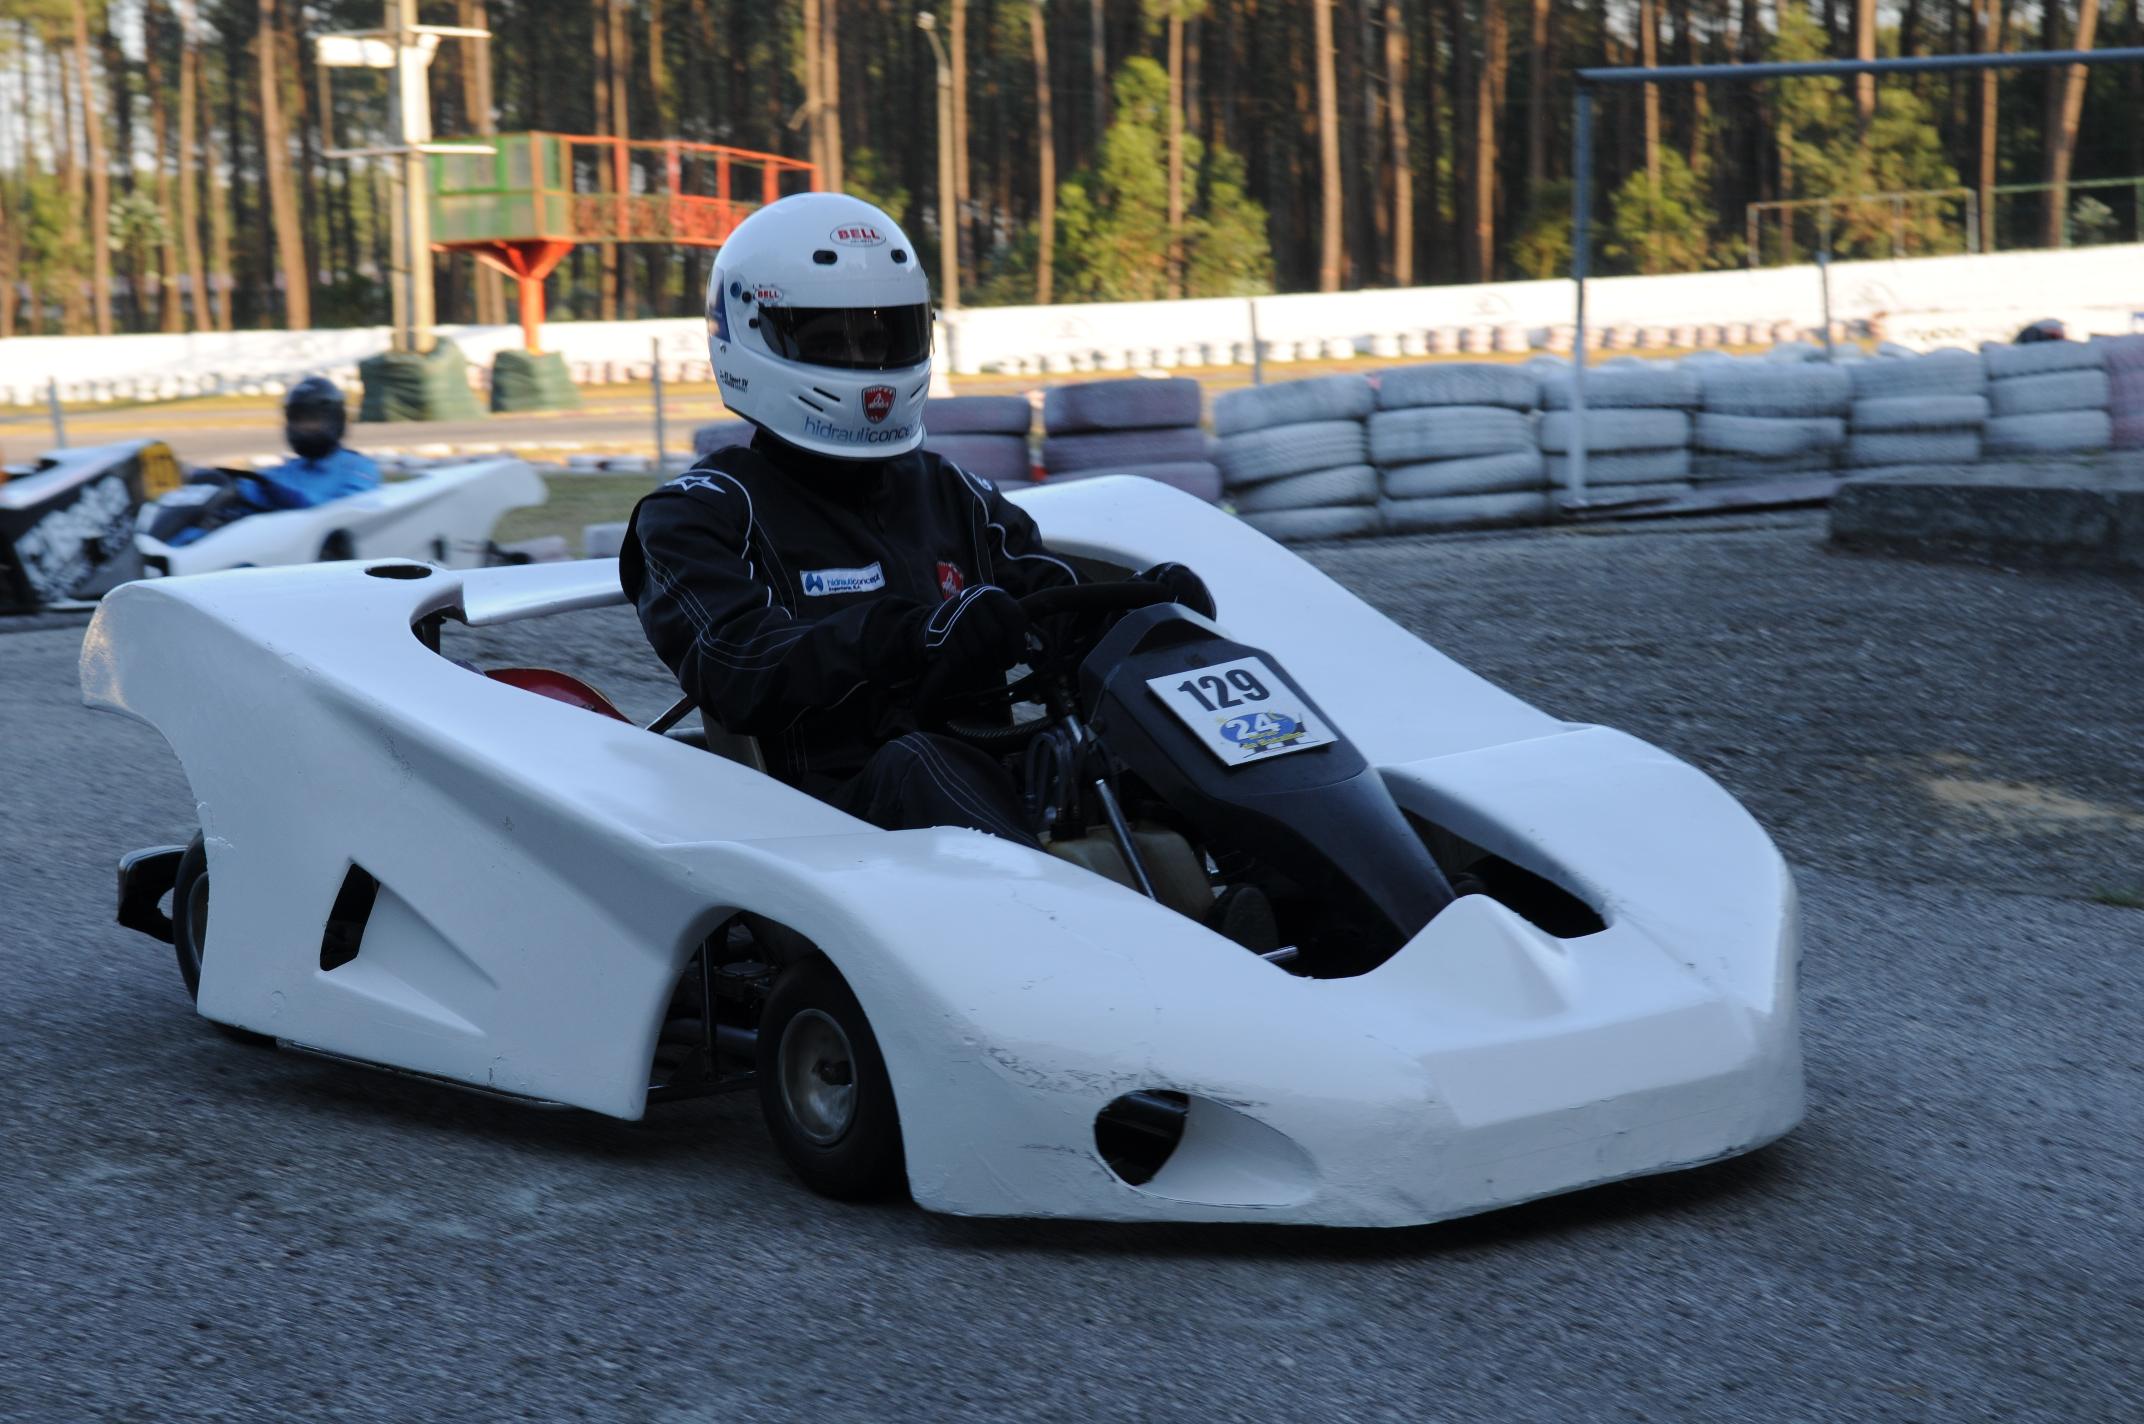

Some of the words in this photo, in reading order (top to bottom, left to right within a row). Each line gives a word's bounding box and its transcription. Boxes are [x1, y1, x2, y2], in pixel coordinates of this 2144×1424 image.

[837, 227, 880, 240] BELL
[757, 289, 779, 299] BELL
[1177, 668, 1271, 712] 129
[1225, 713, 1281, 740] 24
